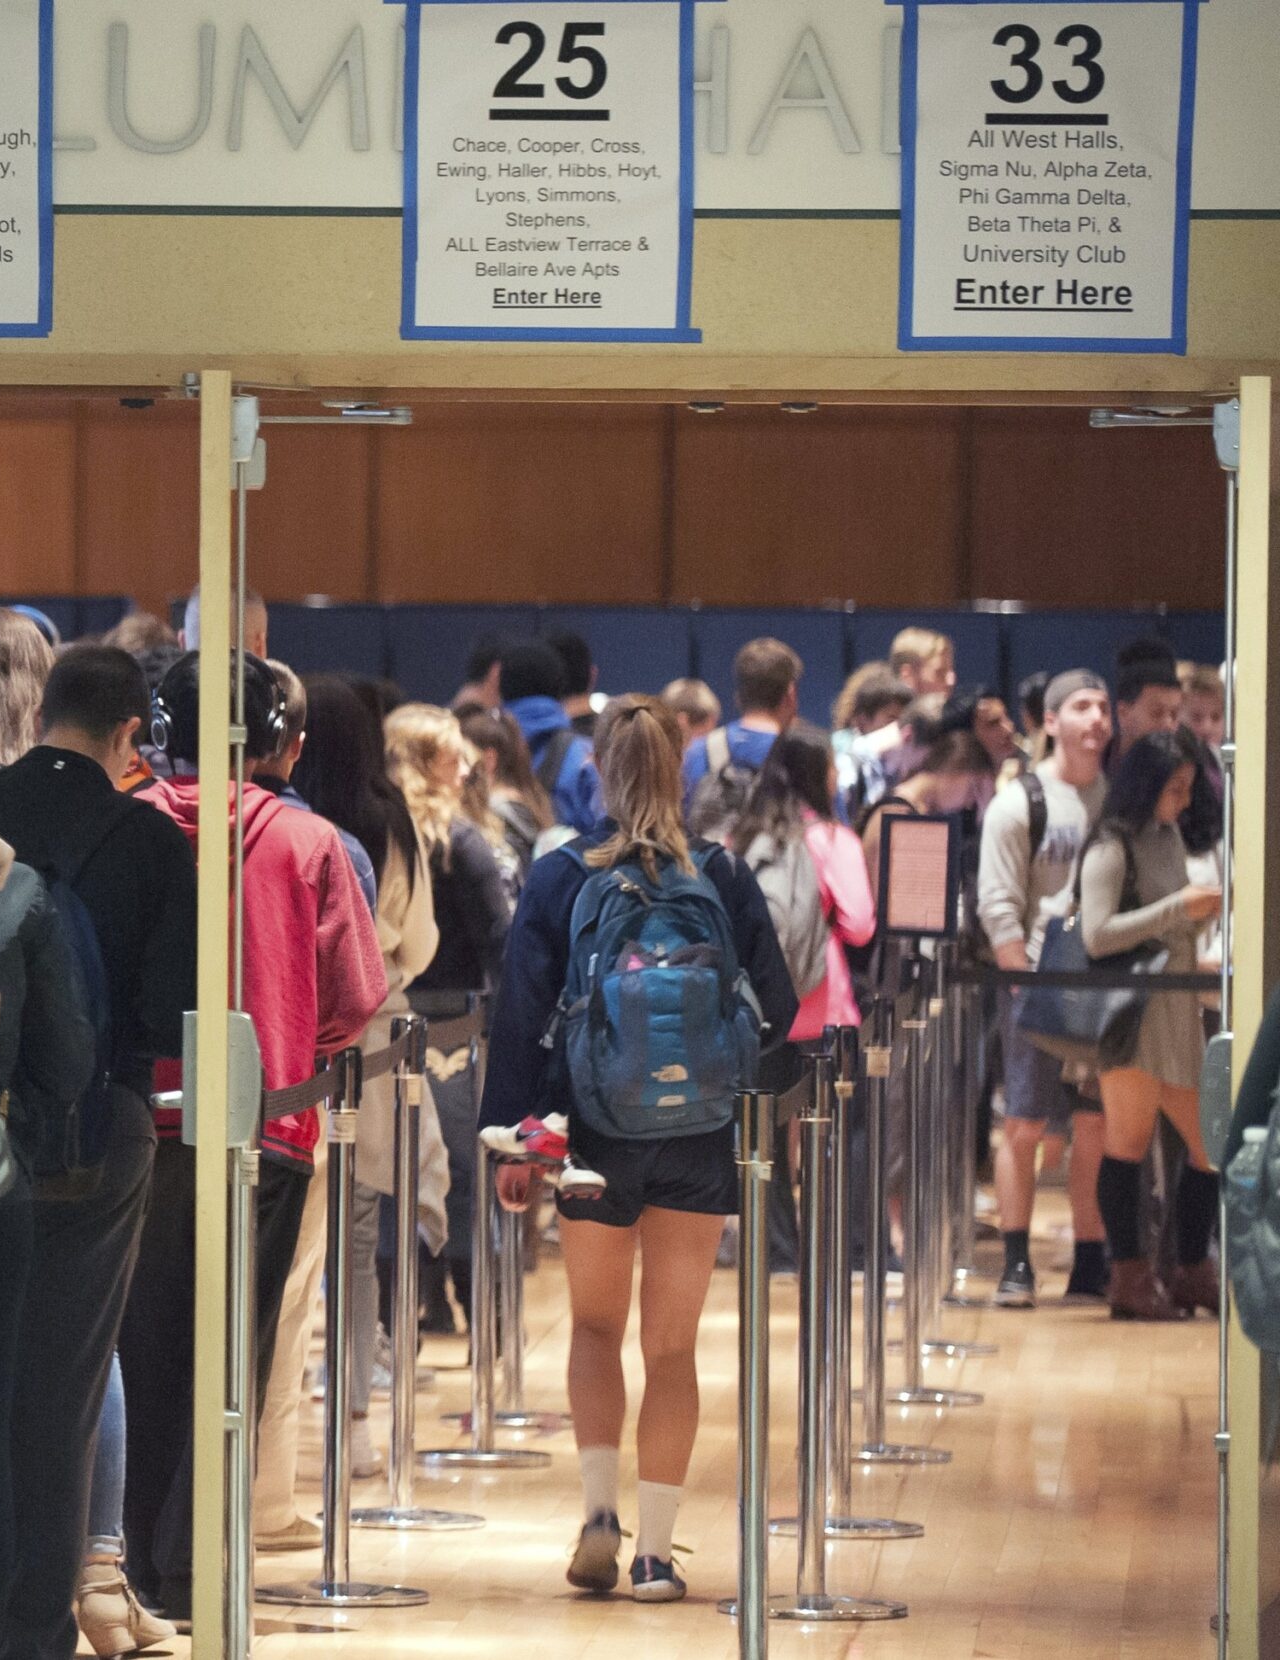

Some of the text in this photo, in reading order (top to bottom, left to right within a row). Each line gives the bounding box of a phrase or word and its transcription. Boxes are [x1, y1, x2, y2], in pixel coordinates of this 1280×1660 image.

[492, 20, 608, 100] 25
[989, 23, 1106, 105] 33
[452, 136, 646, 157] Chace, Cooper, Cross,
[967, 129, 1124, 152] All West Halls,
[436, 161, 662, 182] Ewing, Haller, Hibbs, Hoyt,
[938, 159, 1153, 182] Sigma Nu, Alpha Zeta,
[475, 186, 622, 207] Lyons, Simmons,
[958, 187, 1132, 208] Phi Gamma Delta,
[505, 211, 591, 231] Stephens,
[967, 215, 1011, 233] Beta
[1016, 215, 1072, 234] Theta
[1108, 216, 1123, 234] &
[444, 235, 650, 253] ALL Eastview Terrace &
[963, 243, 1127, 269] University Club
[474, 261, 621, 281] Bellaire Ave Apts
[492, 287, 602, 305] Enter Here
[955, 277, 1133, 306] Enter Here
